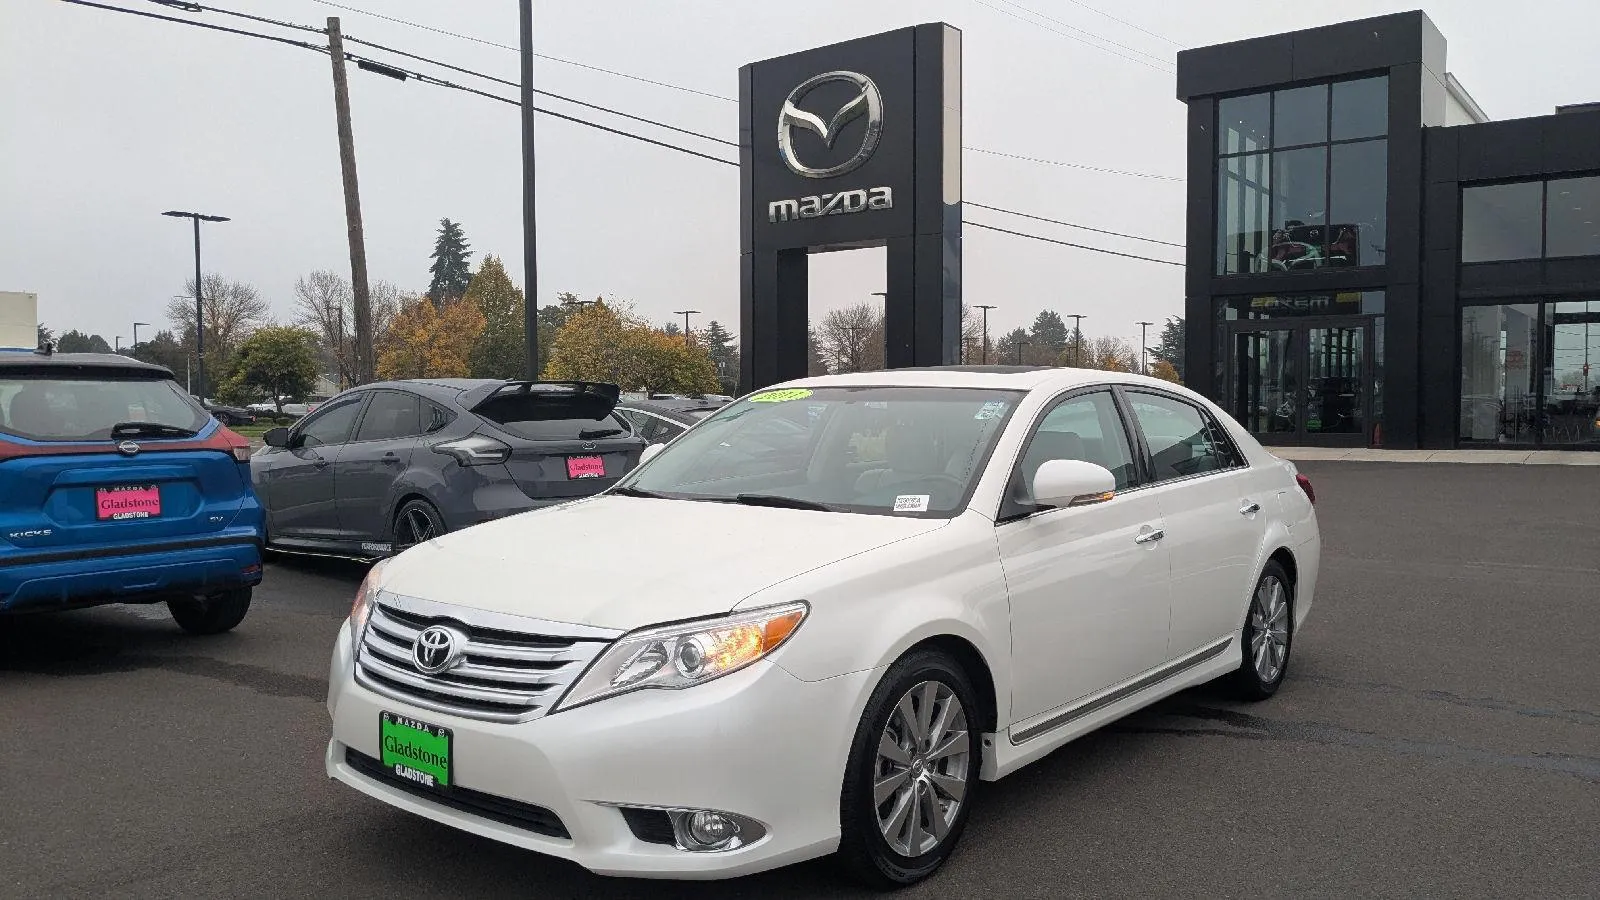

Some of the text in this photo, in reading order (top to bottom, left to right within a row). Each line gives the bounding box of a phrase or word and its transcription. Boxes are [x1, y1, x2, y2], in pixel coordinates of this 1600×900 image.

[768, 186, 893, 223] mazda
[101, 498, 159, 510] Gladstone
[113, 511, 149, 520] GLADSTONE
[9, 529, 52, 538] KICKS
[396, 716, 429, 732] MAZDA
[384, 735, 447, 769] Gladstone
[395, 764, 434, 787] GLADSTONE
